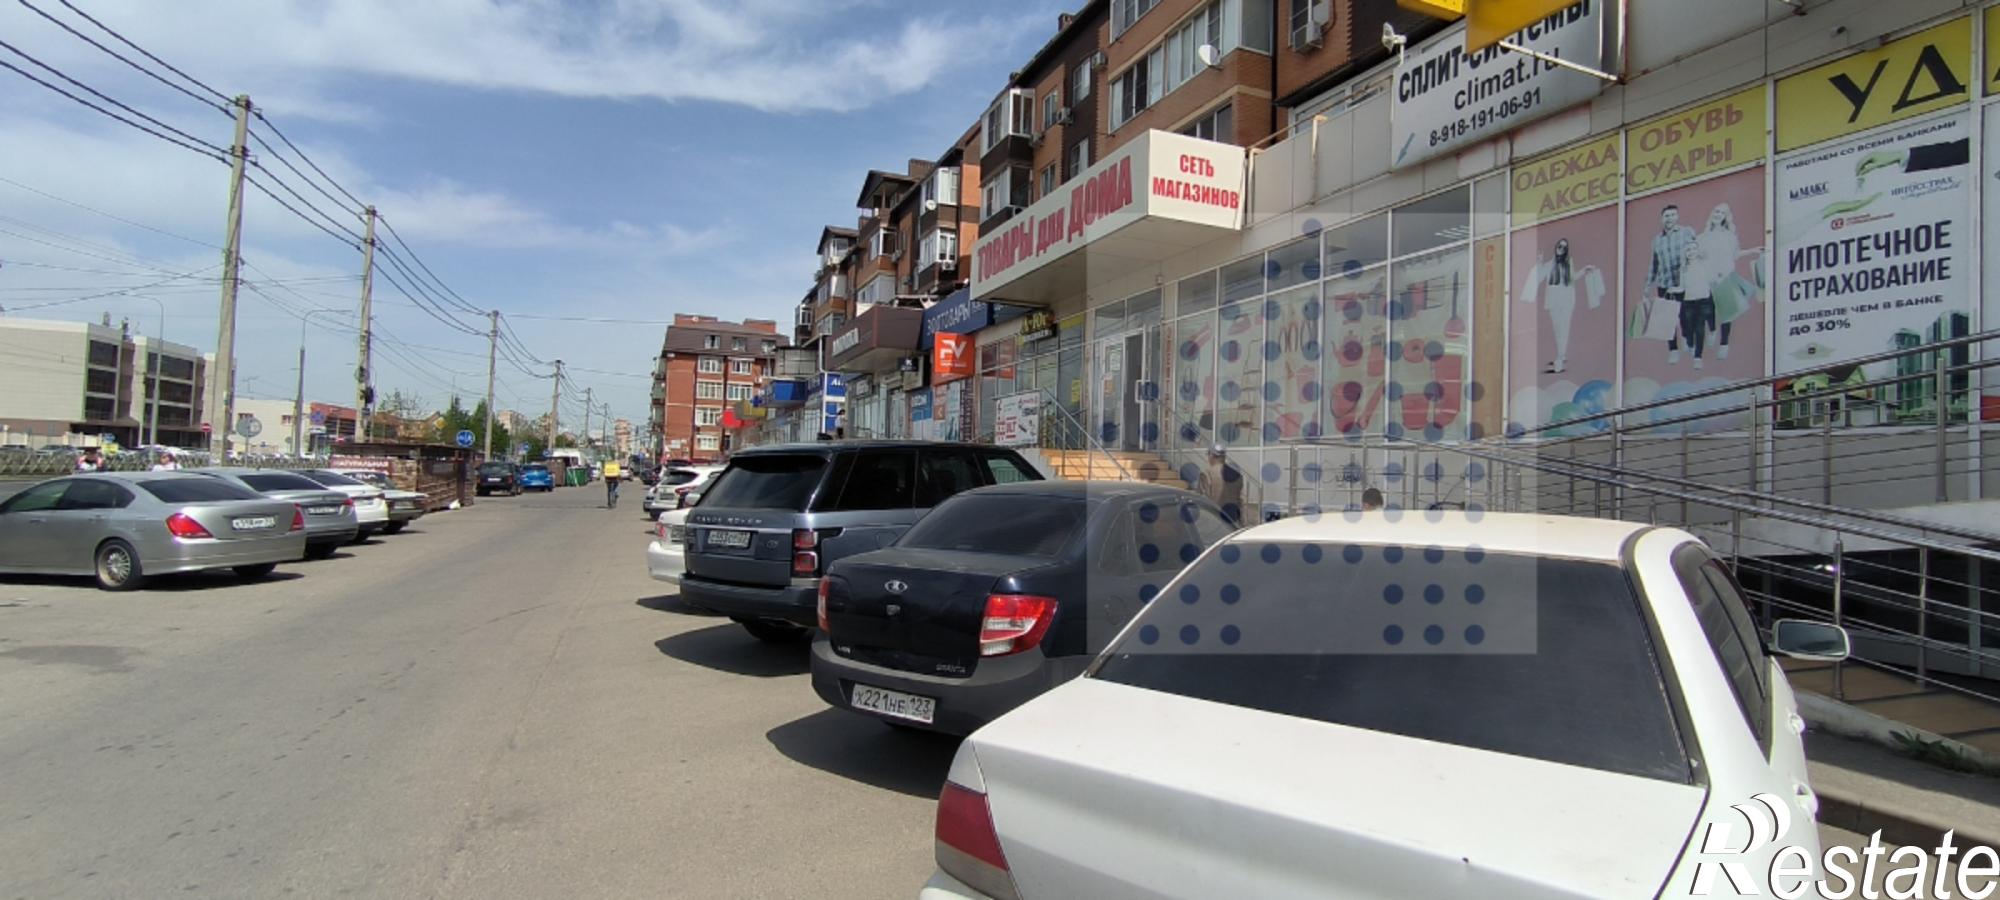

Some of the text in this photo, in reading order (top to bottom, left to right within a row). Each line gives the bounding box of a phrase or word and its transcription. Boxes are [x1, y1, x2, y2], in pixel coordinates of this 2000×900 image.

[1454, 47, 1559, 110] climat.ru
[1429, 86, 1541, 146] 8-918-191-06-91
[1179, 153, 1215, 178] СЕТЬ
[1514, 103, 1744, 192] ОДЕЖДА ОБУВЬ
[1786, 120, 1958, 170] РАБОТАЕМ СО ВСЕМИ БАНКАМИ
[1152, 176, 1240, 210] МАГАЗИНОВ
[1538, 138, 1733, 214] АКСЕССУАРЫ
[977, 215, 1035, 284] ТОВАРЫ
[1068, 155, 1133, 244] ДОМА
[1789, 219, 1952, 274] ИПОТЕЧНОЕ
[1789, 256, 1952, 302] СТРАХОВАНИЕ
[1789, 294, 1943, 322] ДЕШЕВЛЕ ЧЕМ В БАНКЕ
[1815, 318, 1851, 334] 30%
